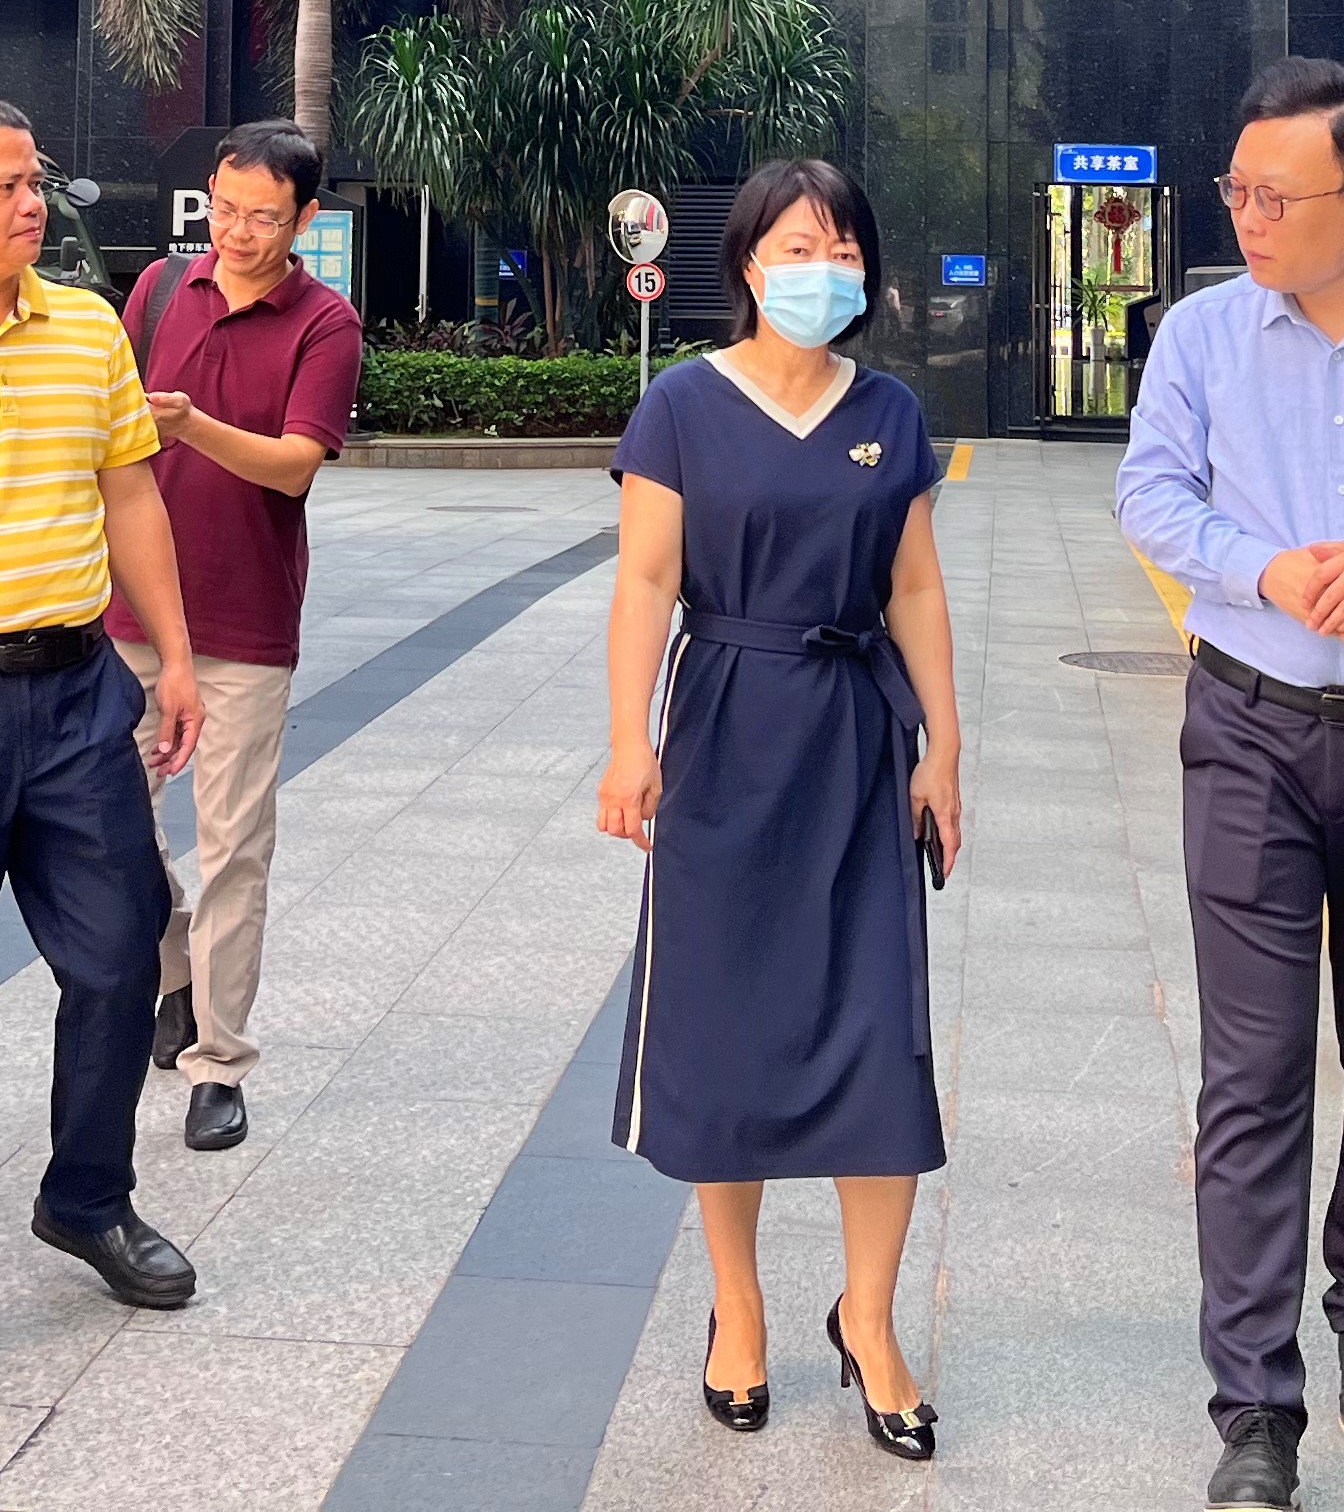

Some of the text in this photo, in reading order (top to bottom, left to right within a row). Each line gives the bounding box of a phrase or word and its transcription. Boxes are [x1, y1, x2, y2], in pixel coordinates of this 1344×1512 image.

[1073, 155, 1139, 172] 共享茶室
[172, 189, 209, 237] P
[635, 271, 656, 293] 15
